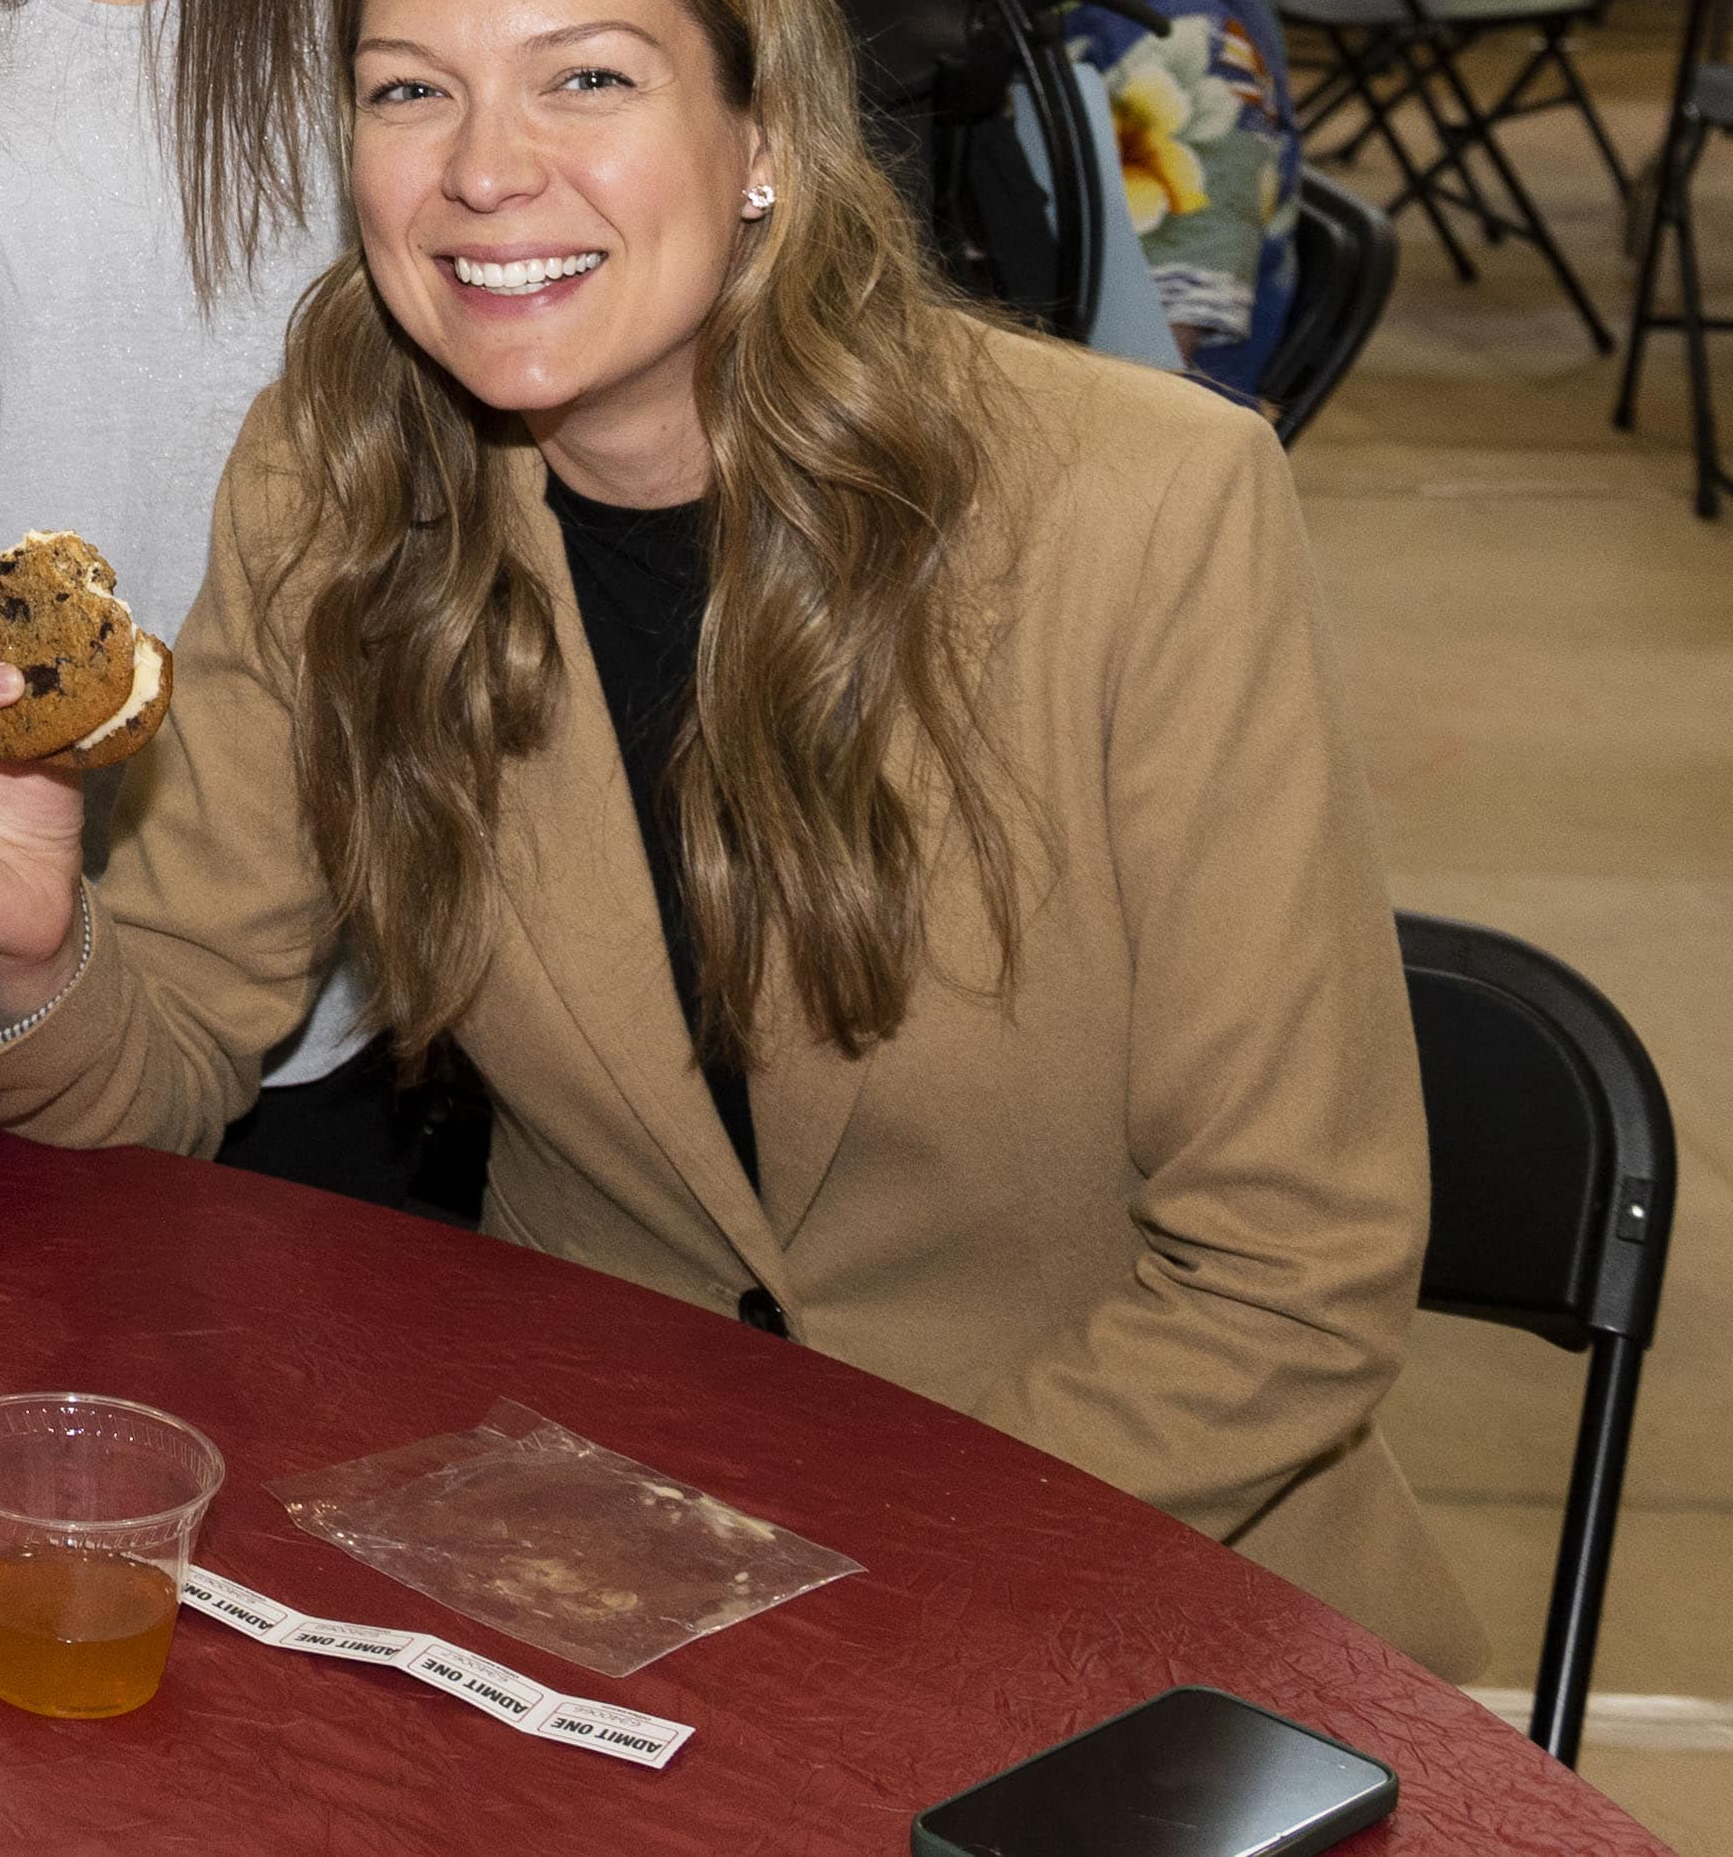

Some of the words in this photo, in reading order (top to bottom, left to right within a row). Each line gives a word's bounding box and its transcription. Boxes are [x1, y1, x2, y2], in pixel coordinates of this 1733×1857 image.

[184, 1582, 210, 1602] ON
[212, 1599, 275, 1631] ADMIT
[294, 1632, 335, 1646] ONE
[335, 1639, 402, 1656] ADMIT
[421, 1657, 463, 1682] ONE
[464, 1679, 529, 1714] ADMIT
[550, 1716, 593, 1735] ONE
[595, 1729, 663, 1754] ADMIT
